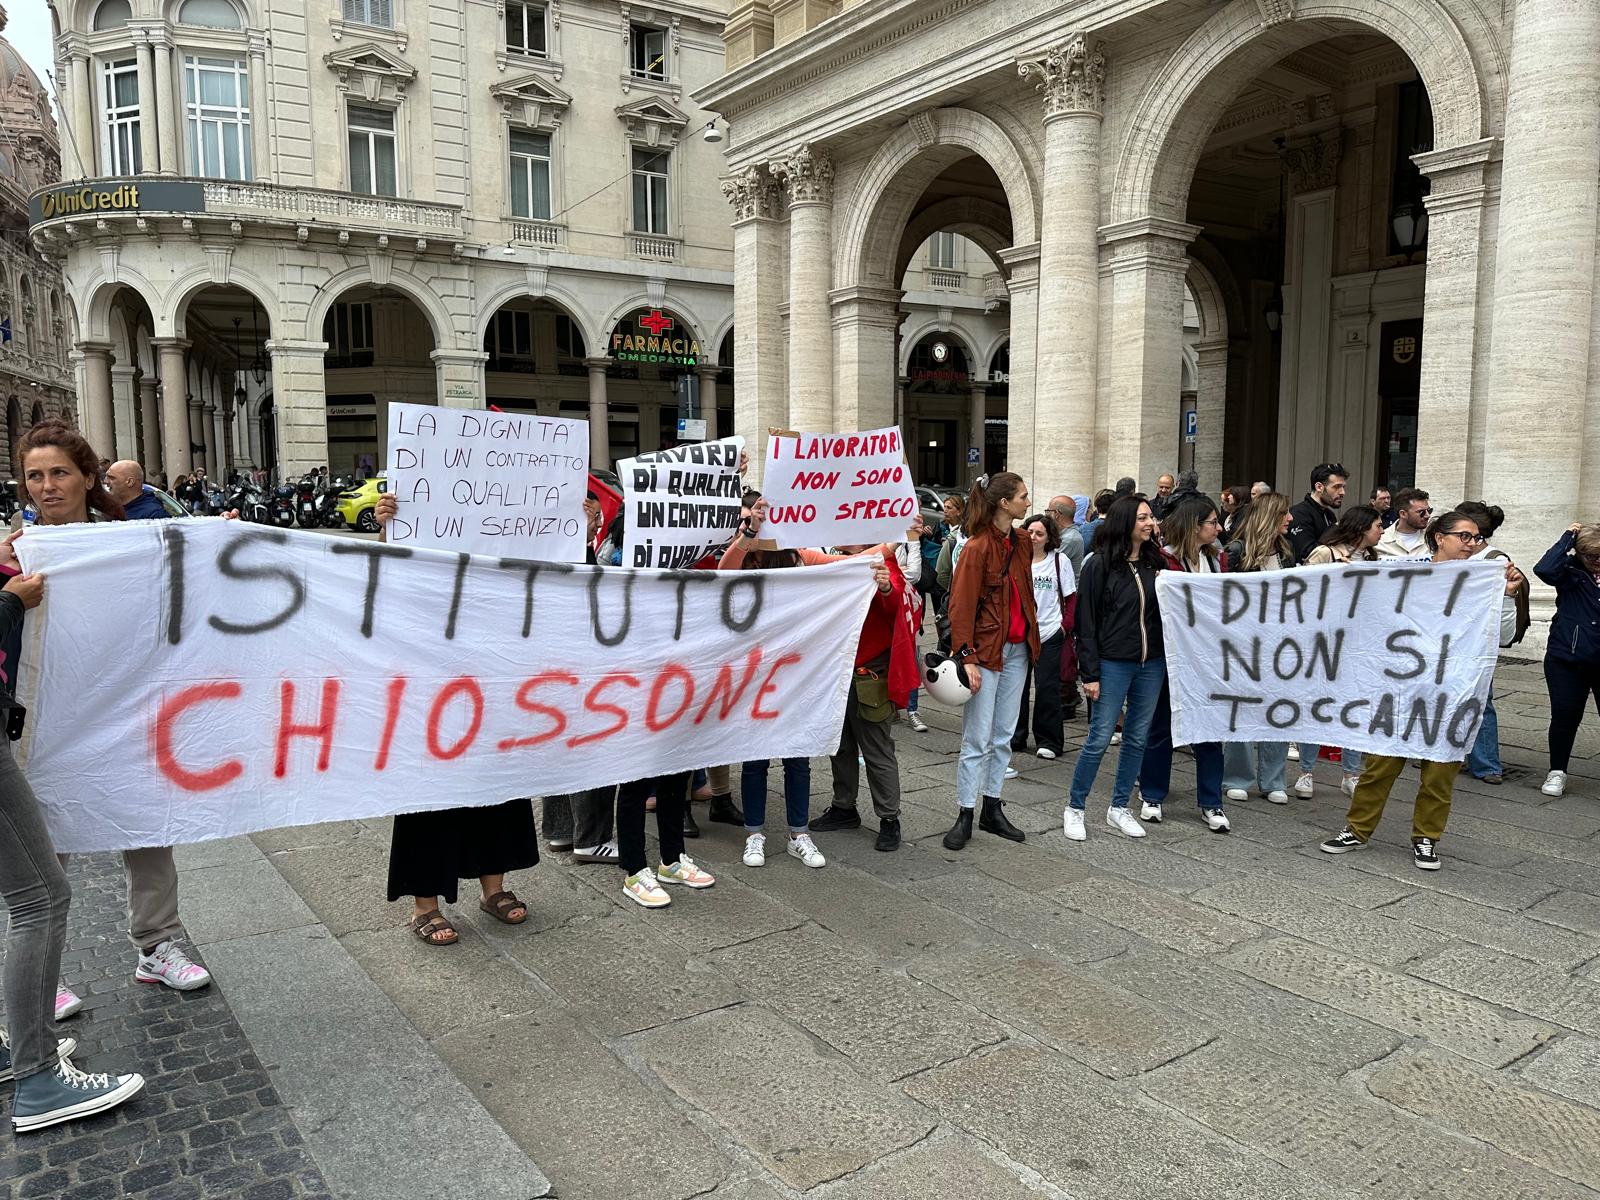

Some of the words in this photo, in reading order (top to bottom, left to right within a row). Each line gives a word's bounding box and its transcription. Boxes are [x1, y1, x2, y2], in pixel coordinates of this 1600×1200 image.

[55, 185, 139, 214] UniCredit
[613, 334, 700, 355] FARMACIA
[1352, 332, 1360, 340] 2
[617, 352, 696, 365] OMEOPATIA
[398, 411, 437, 437] LA
[1188, 412, 1197, 433] P
[773, 437, 780, 460] I
[794, 430, 901, 461] LAVORATORI
[395, 448, 425, 470] DI
[444, 447, 472, 469] UN
[485, 450, 584, 471] CONTRATTO
[394, 478, 430, 503] LA
[790, 471, 841, 491] NON
[851, 466, 903, 487] SONO
[637, 501, 665, 528] UN
[769, 504, 817, 525] UNO
[835, 497, 914, 521] SPRECO
[392, 516, 419, 541] DI
[434, 516, 464, 538] UN
[480, 516, 579, 538] SERVIZIO
[164, 523, 768, 648] ISTITUTO
[1182, 582, 1197, 628] I
[1221, 568, 1471, 625] DIRITTI
[1220, 628, 1346, 683] NON
[1383, 629, 1451, 686] SI
[154, 644, 802, 793] CHIOSSONE
[1208, 691, 1483, 749] TOCCANO
